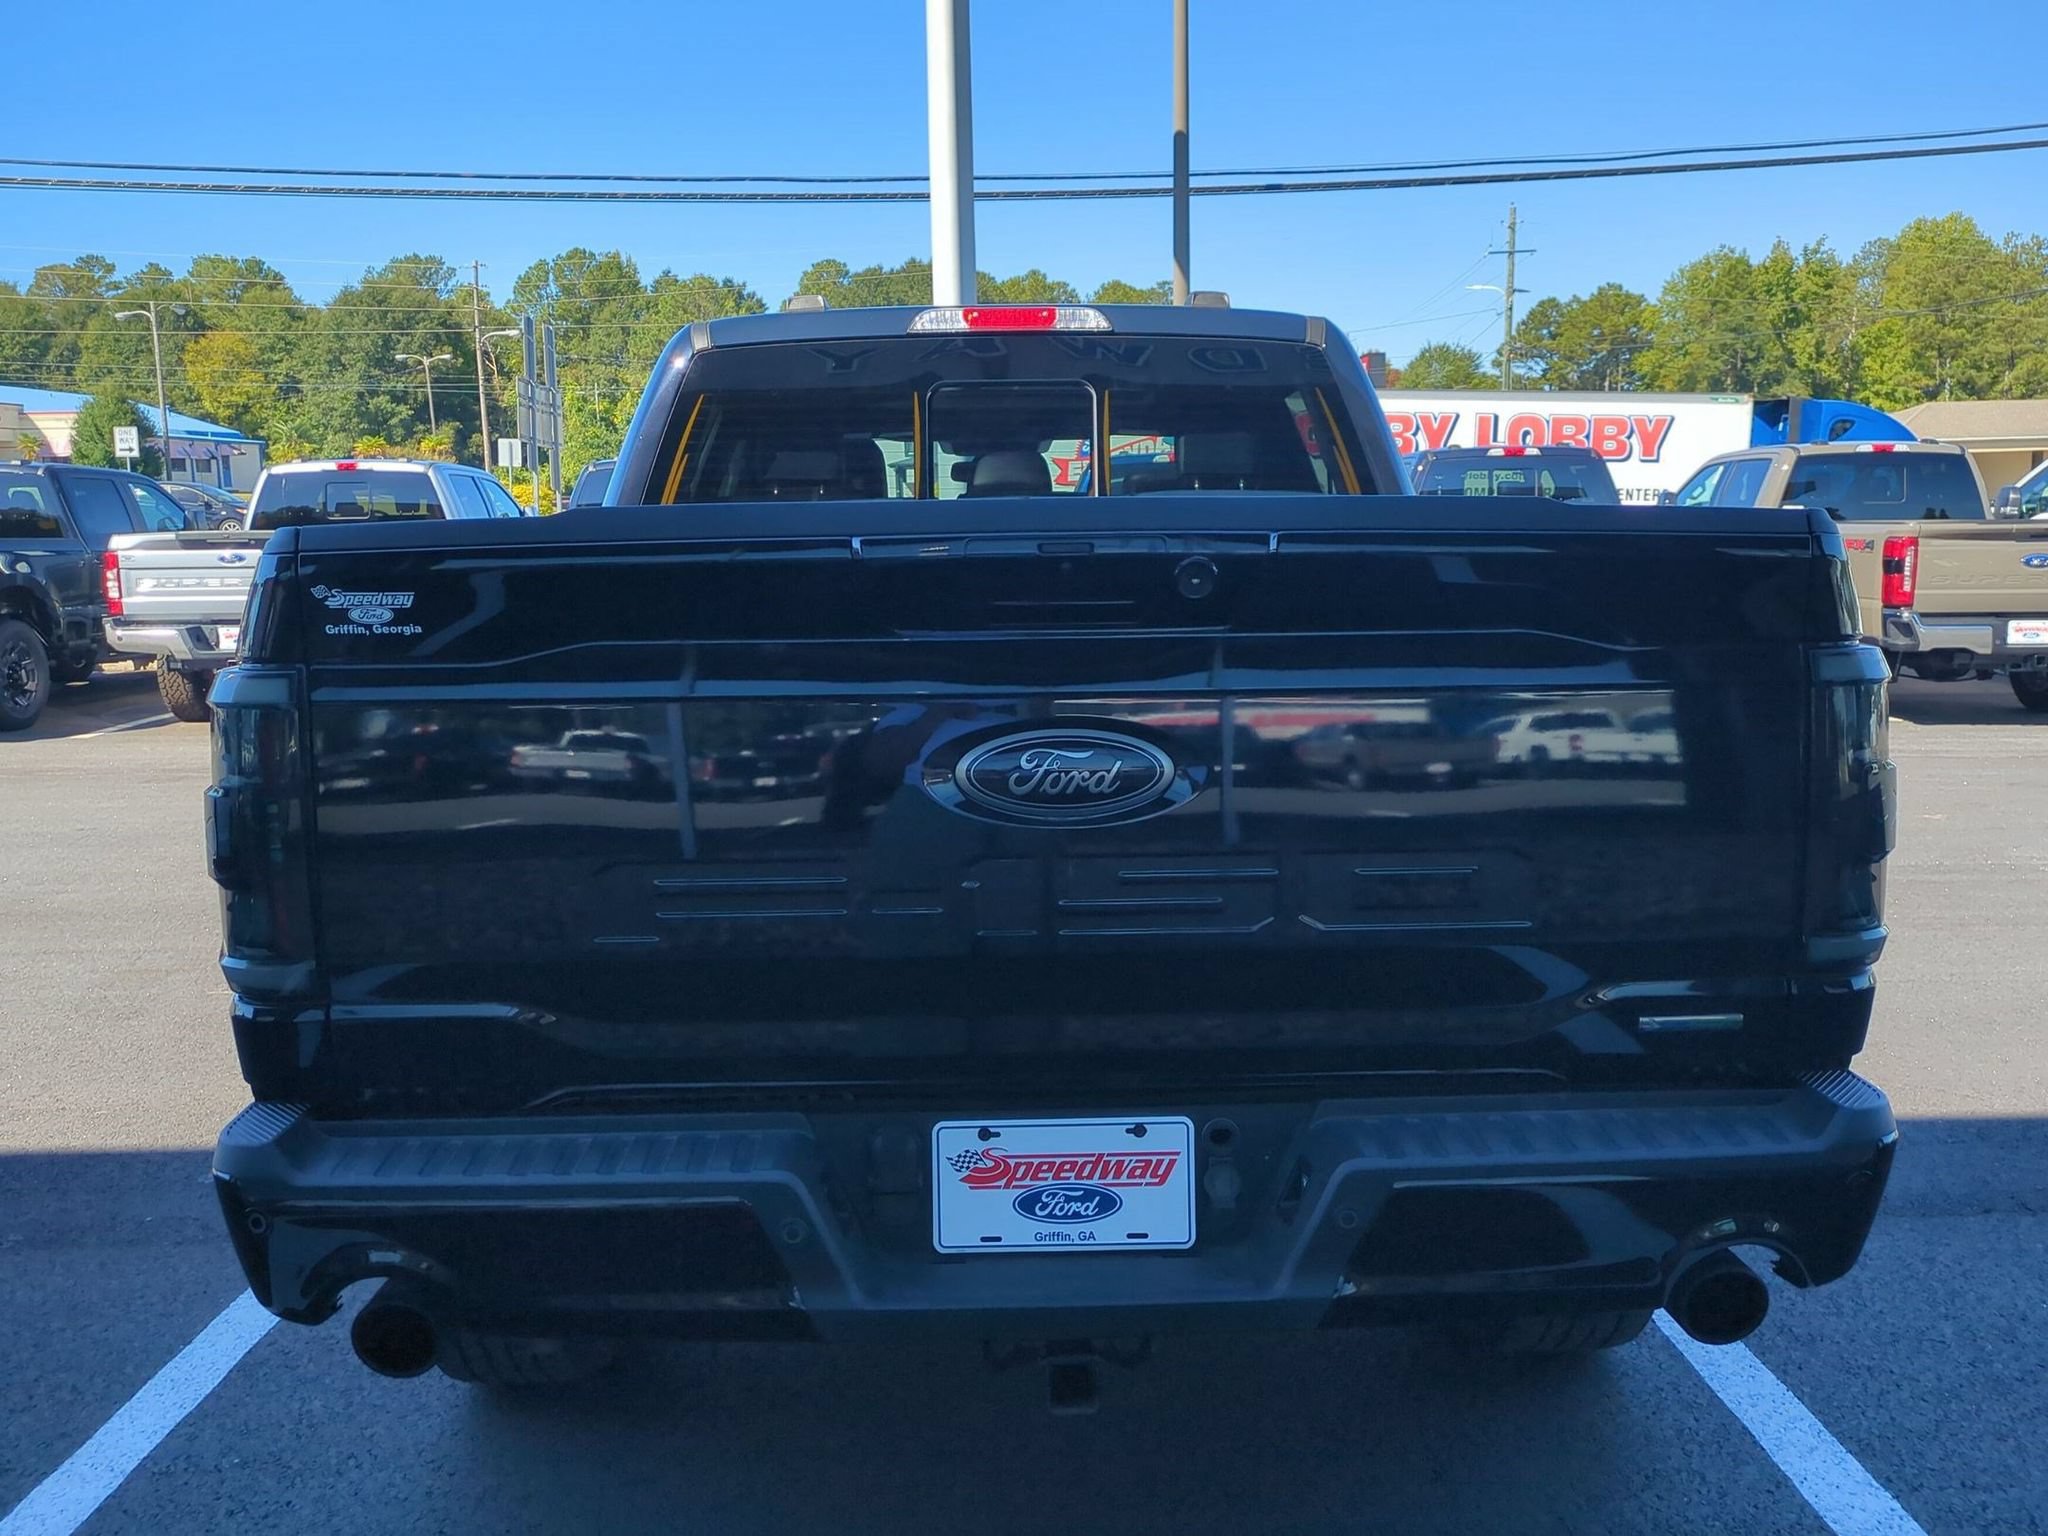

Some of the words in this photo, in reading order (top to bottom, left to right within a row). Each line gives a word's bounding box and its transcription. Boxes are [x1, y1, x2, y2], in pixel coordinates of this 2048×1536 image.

[1473, 412, 1675, 463] LOBBY
[1616, 488, 1660, 501] ENTER
[324, 588, 415, 608] Speedway
[358, 608, 385, 620] Ford
[325, 624, 370, 636] Griffin,
[372, 623, 422, 636] Georgia
[1008, 748, 1122, 796] Ford
[959, 1147, 1182, 1191] Speedway
[1034, 1189, 1100, 1217] Ford
[1033, 1231, 1075, 1244] Griffin,
[1077, 1230, 1097, 1242] GA
